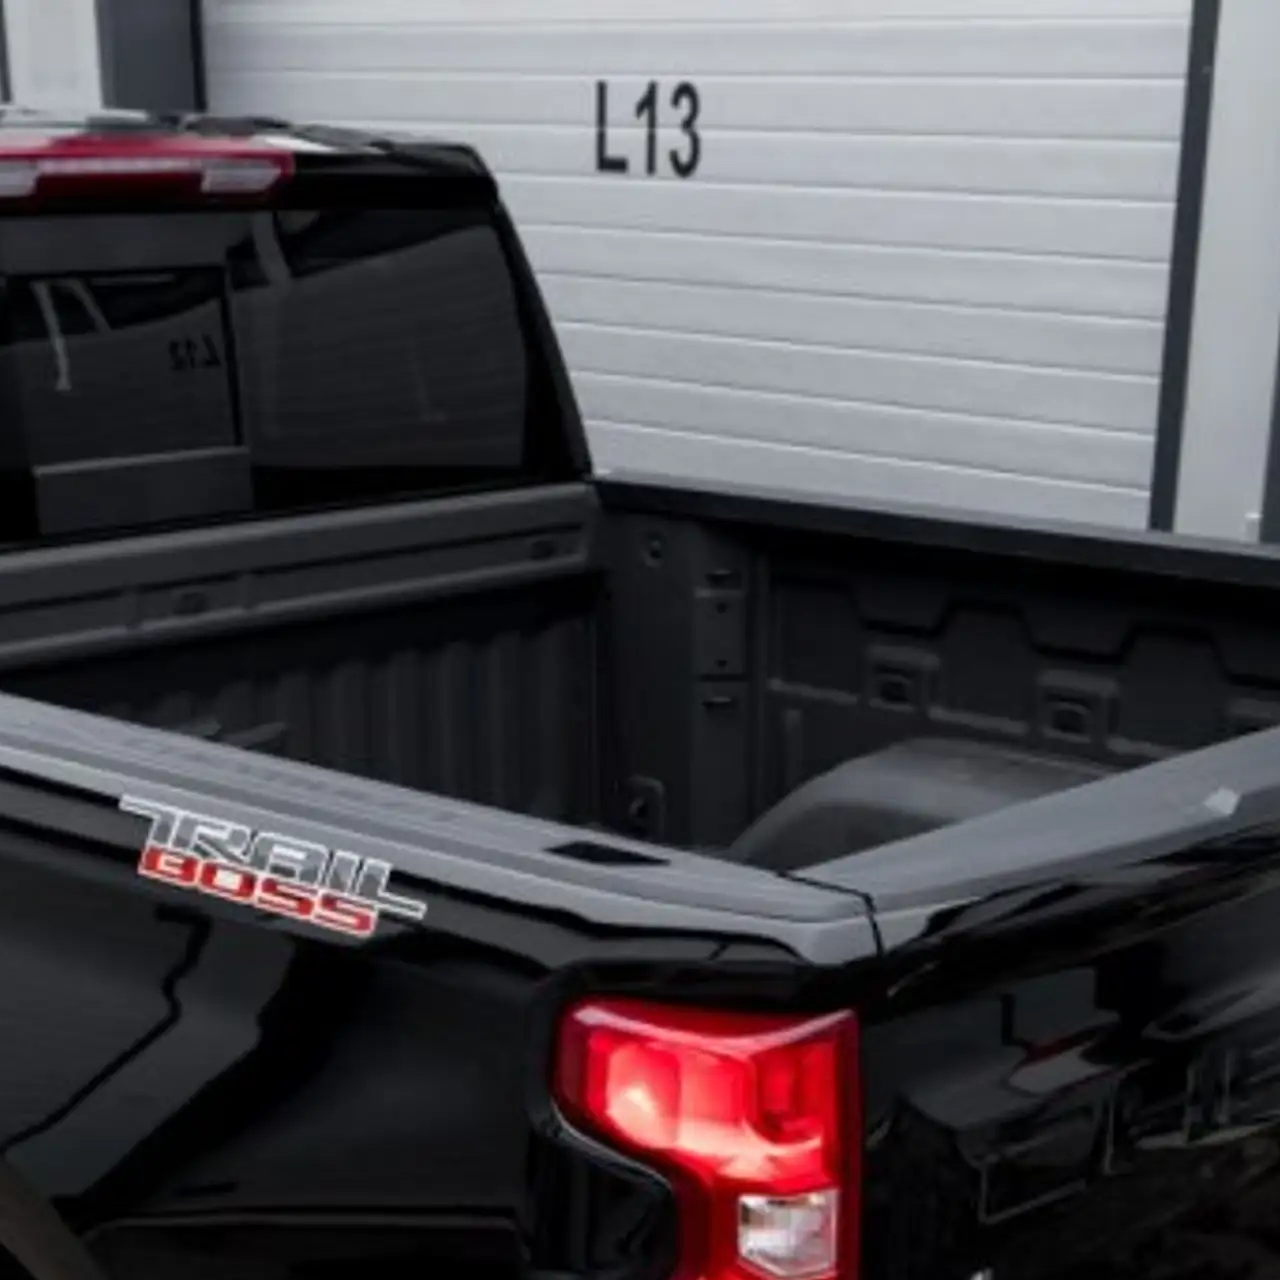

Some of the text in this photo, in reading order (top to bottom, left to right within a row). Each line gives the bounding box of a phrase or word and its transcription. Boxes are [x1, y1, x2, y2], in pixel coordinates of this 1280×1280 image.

[596, 80, 701, 180] L13
[118, 794, 428, 921] TRAIL
[138, 842, 380, 938] BOSS
